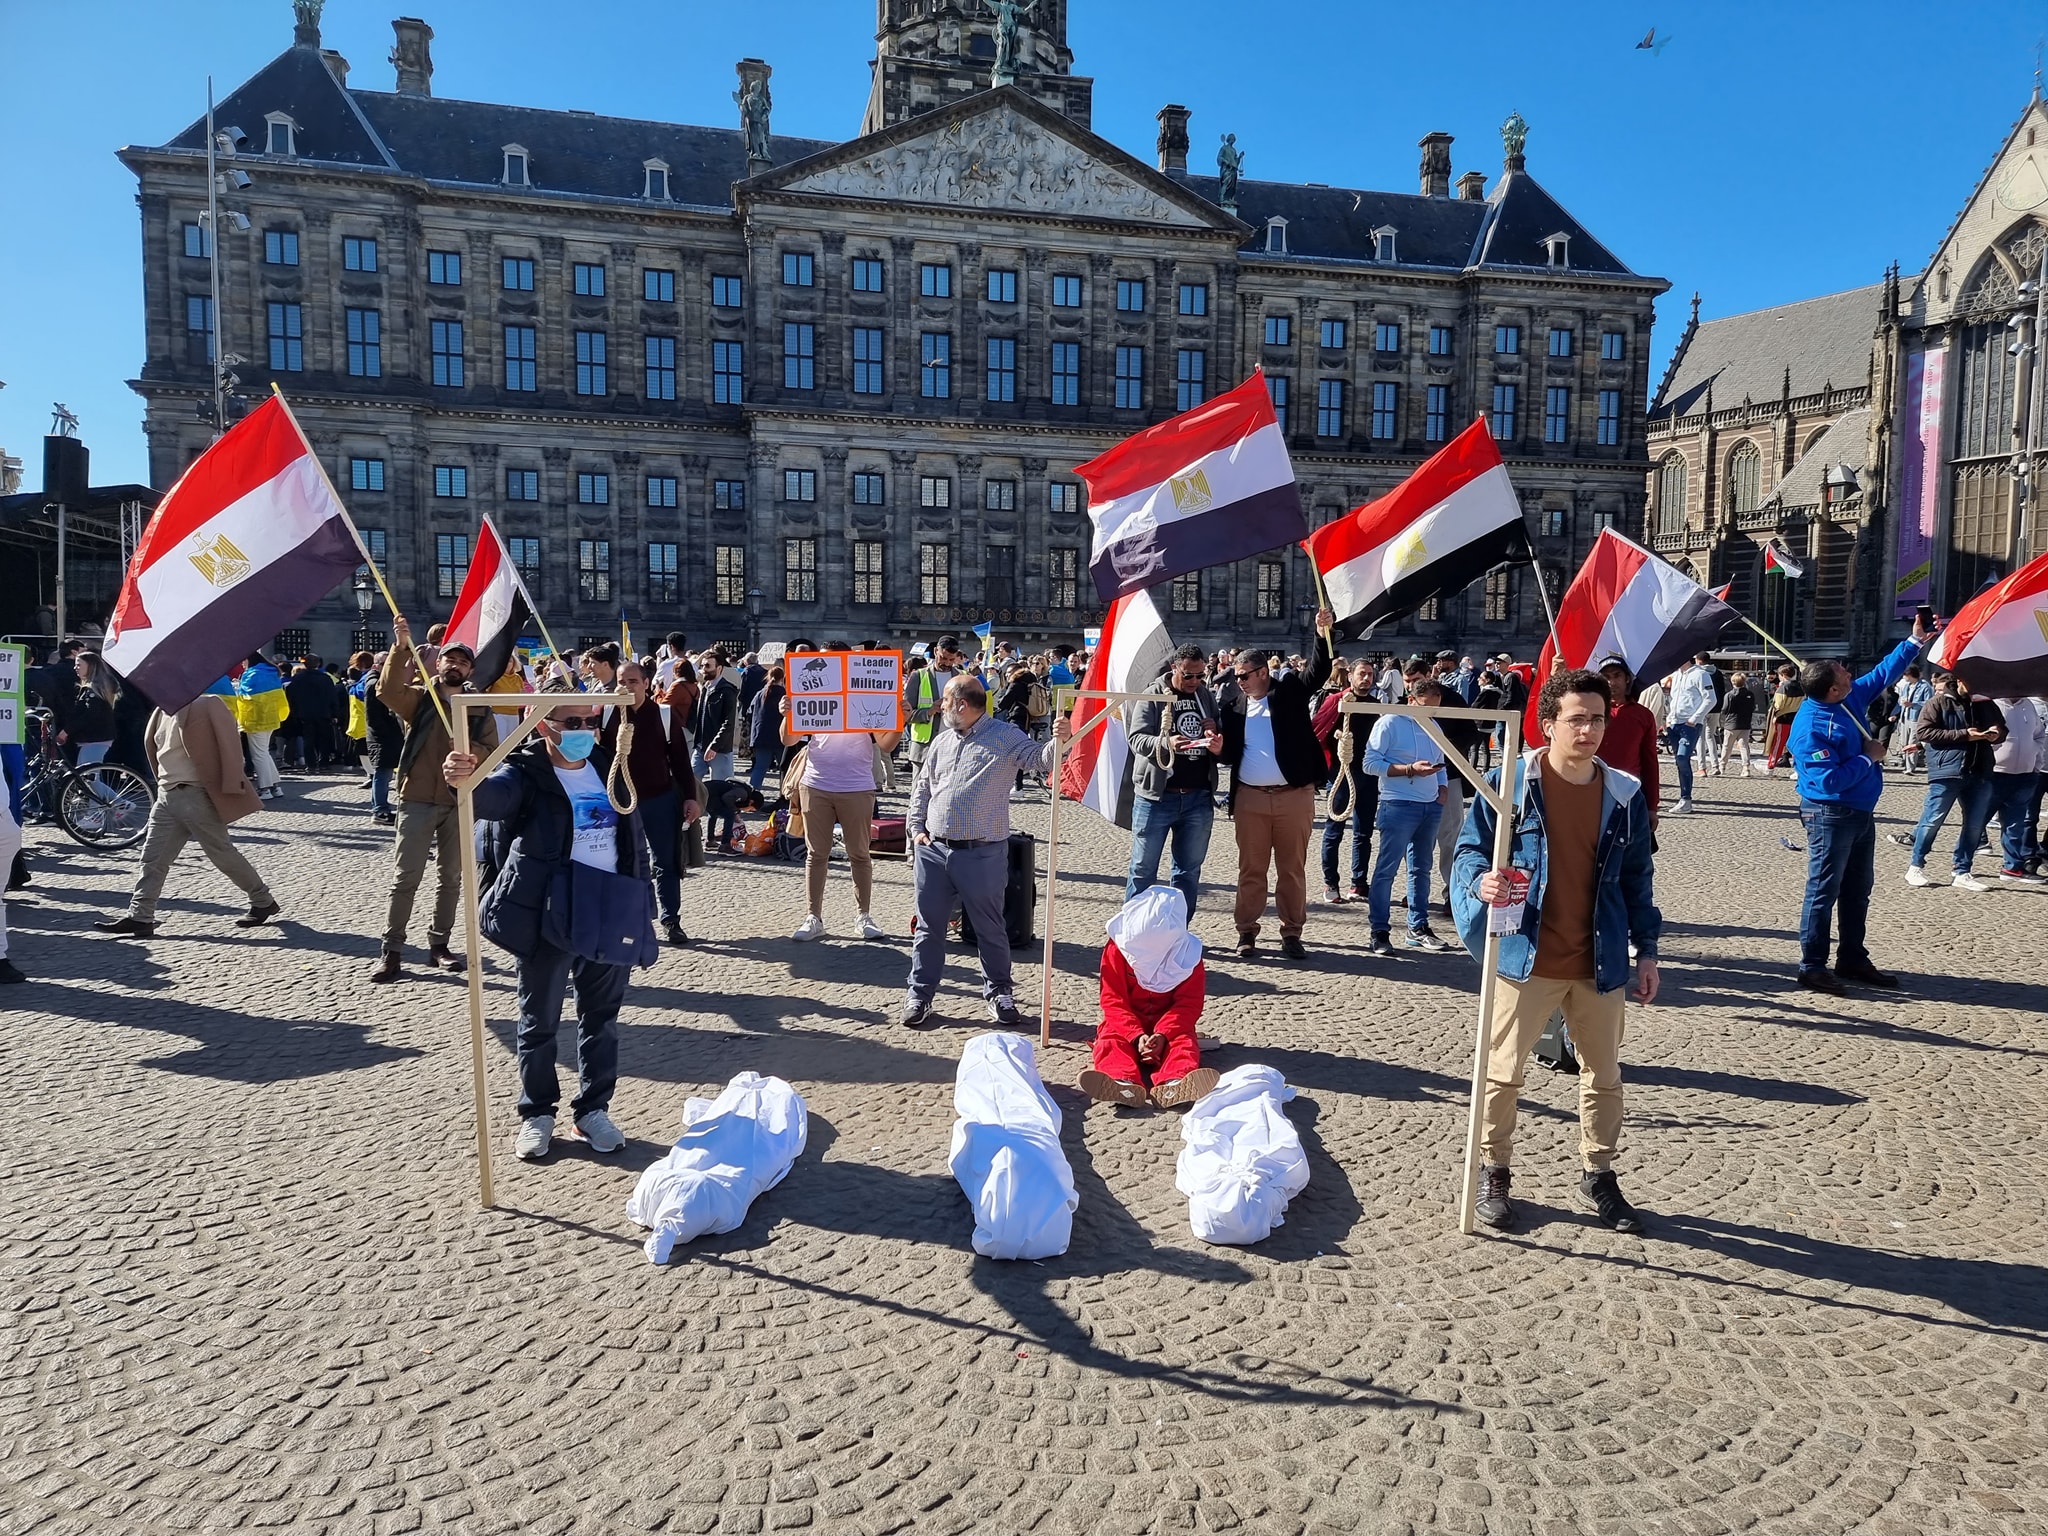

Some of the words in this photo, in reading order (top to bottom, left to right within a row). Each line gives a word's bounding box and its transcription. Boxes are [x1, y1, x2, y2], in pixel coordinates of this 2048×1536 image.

[1926, 363, 1935, 388] history
[1924, 389, 1932, 417] fashion
[862, 657, 894, 667] Leader
[801, 676, 824, 691] SISI
[850, 677, 894, 690] Military
[796, 700, 838, 716] COUP
[801, 718, 810, 727] in
[811, 718, 832, 727] Egypt
